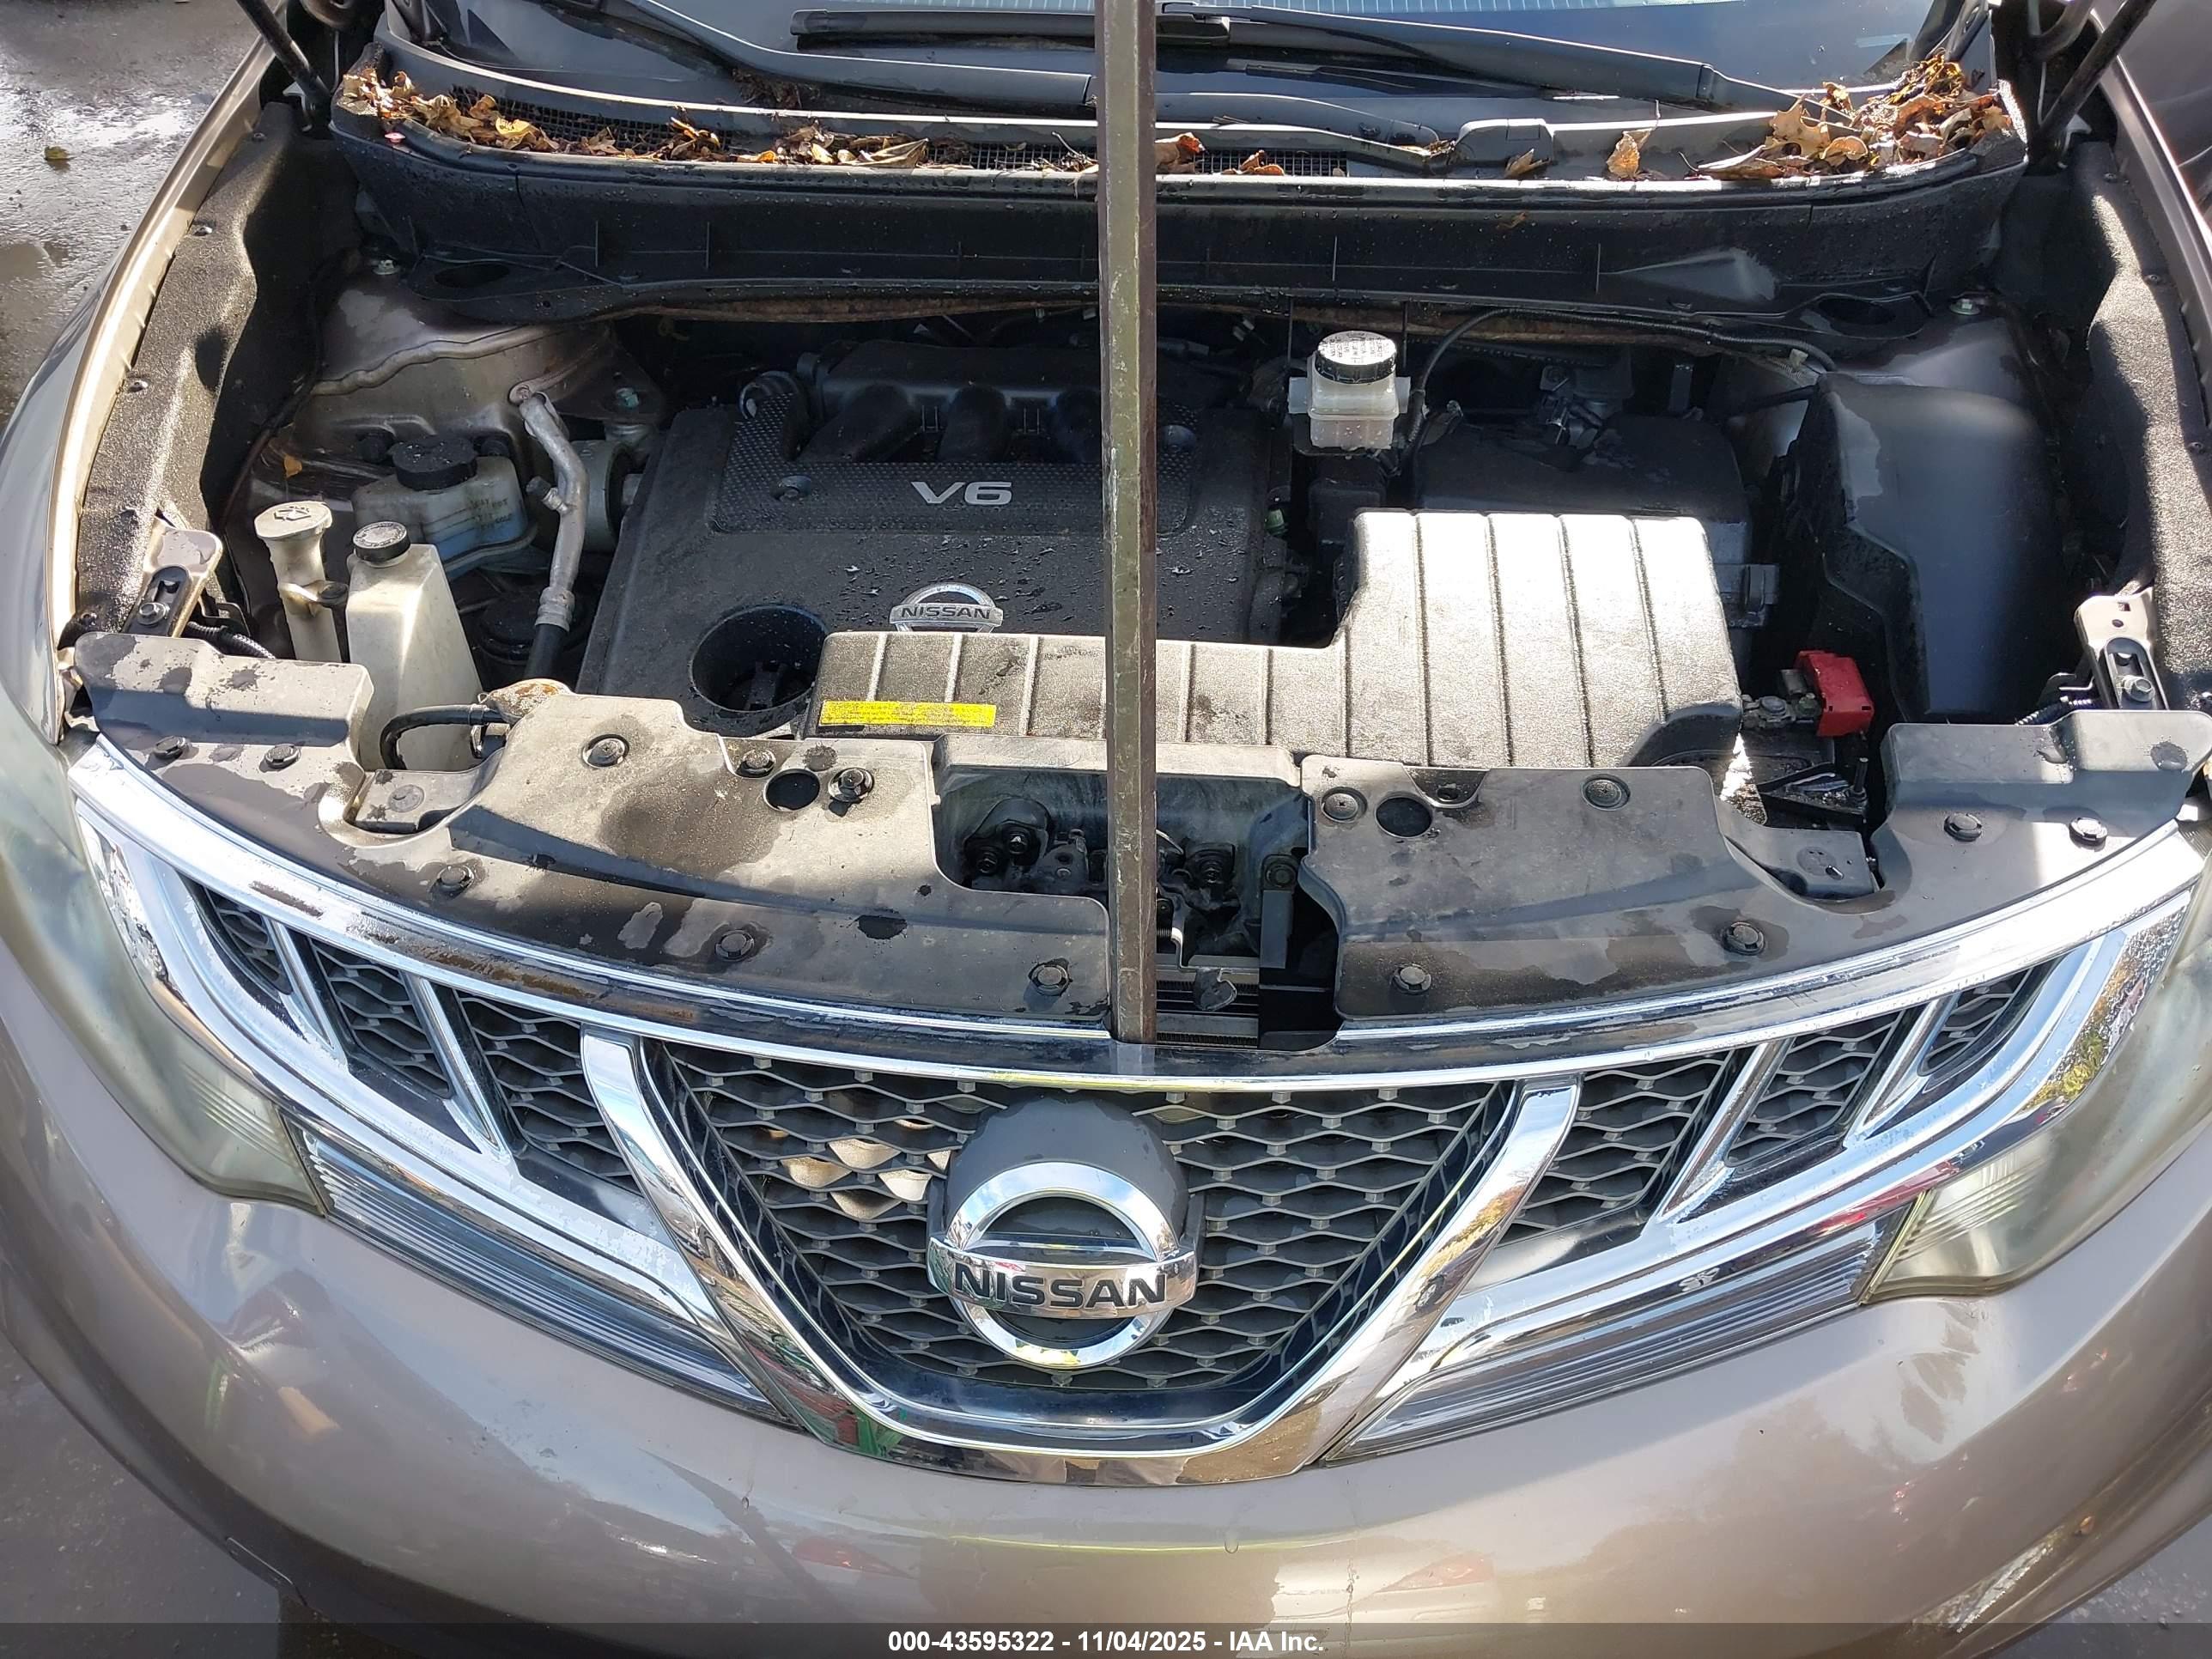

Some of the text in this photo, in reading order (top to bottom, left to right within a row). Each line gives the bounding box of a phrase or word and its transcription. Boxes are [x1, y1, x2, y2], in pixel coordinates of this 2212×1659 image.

[910, 481, 1012, 505] V6
[901, 605, 990, 619] NISSAN
[954, 1261, 1168, 1310] NISSAN
